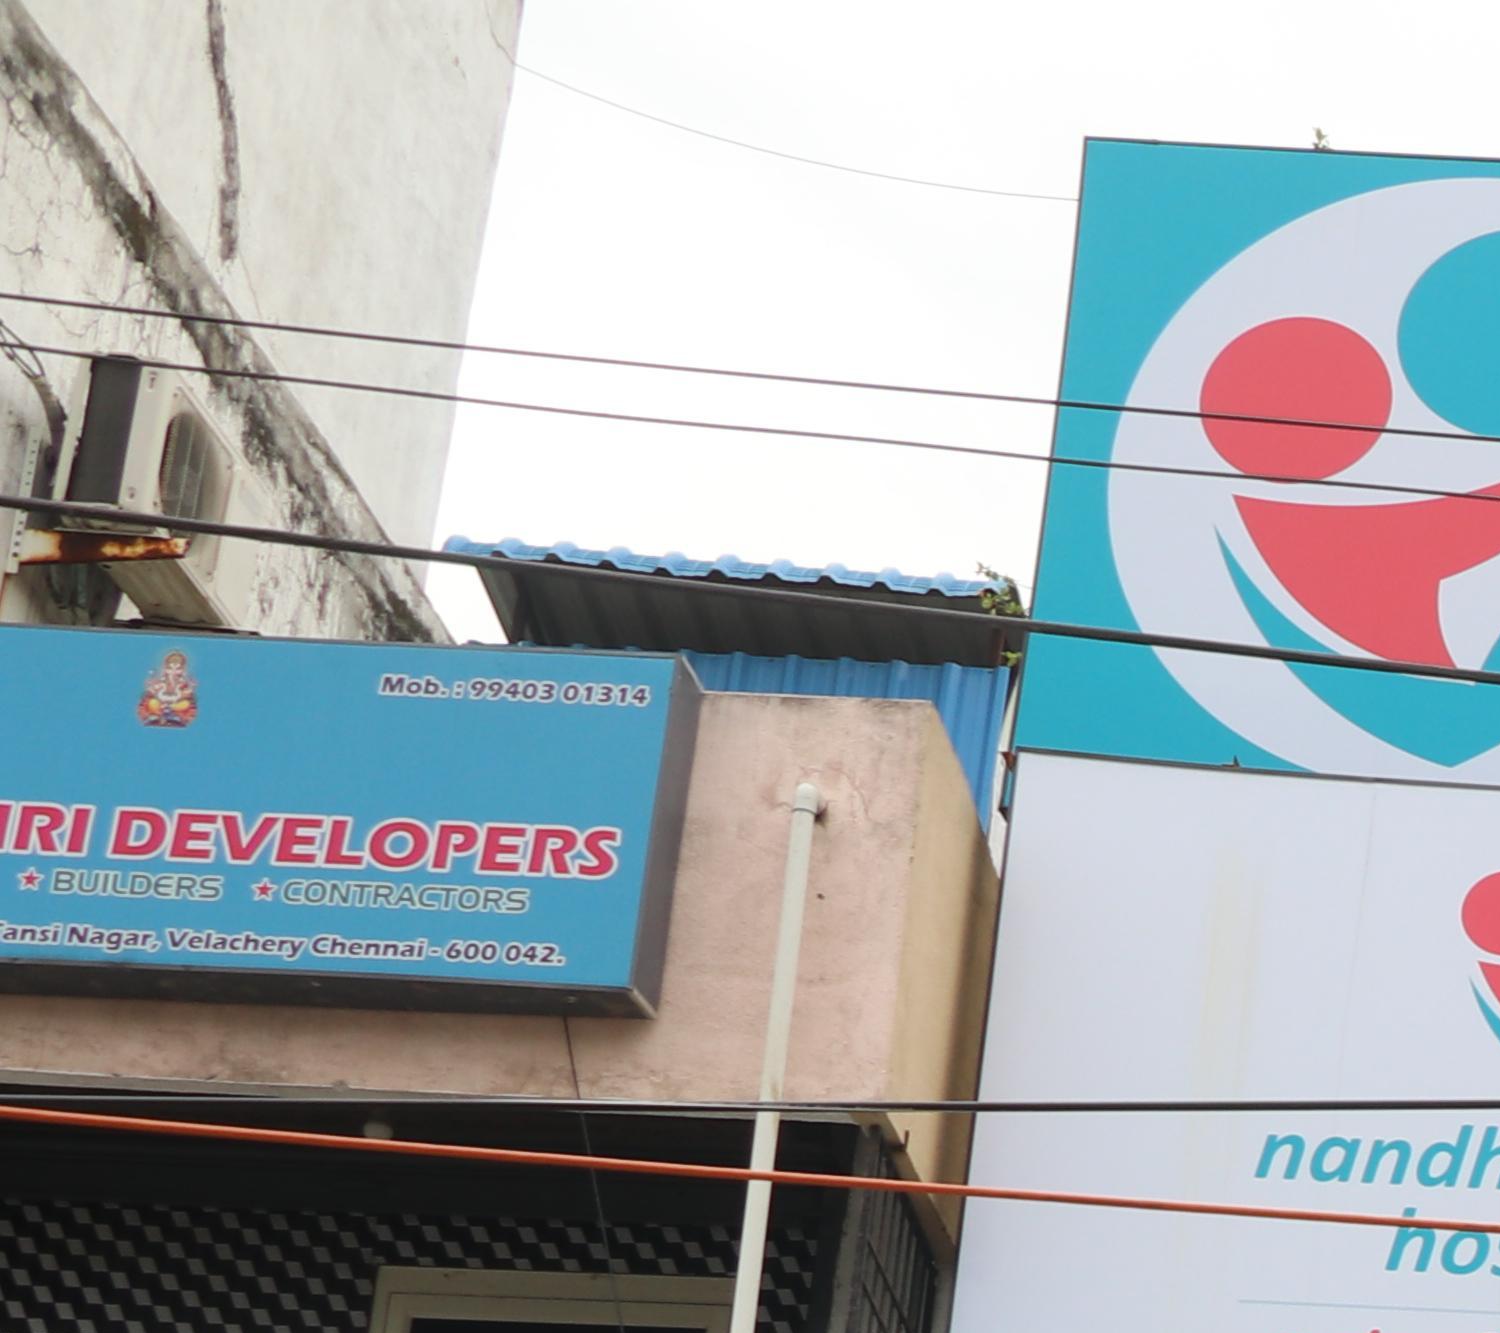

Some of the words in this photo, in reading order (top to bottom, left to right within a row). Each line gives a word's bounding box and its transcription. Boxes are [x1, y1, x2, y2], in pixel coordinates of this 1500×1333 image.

[378, 673, 449, 698] Mob.
[468, 677, 556, 703] 99403
[562, 681, 651, 706] 01314
[110, 807, 621, 879] DEVELOPERS
[51, 869, 224, 900] BUILDERS
[282, 879, 530, 914] CONTRACTORS
[68, 924, 160, 952] Nagar,
[169, 928, 305, 960] Velachery
[311, 935, 424, 959] Chennai
[446, 940, 498, 962] 600
[504, 942, 564, 964] 042.
